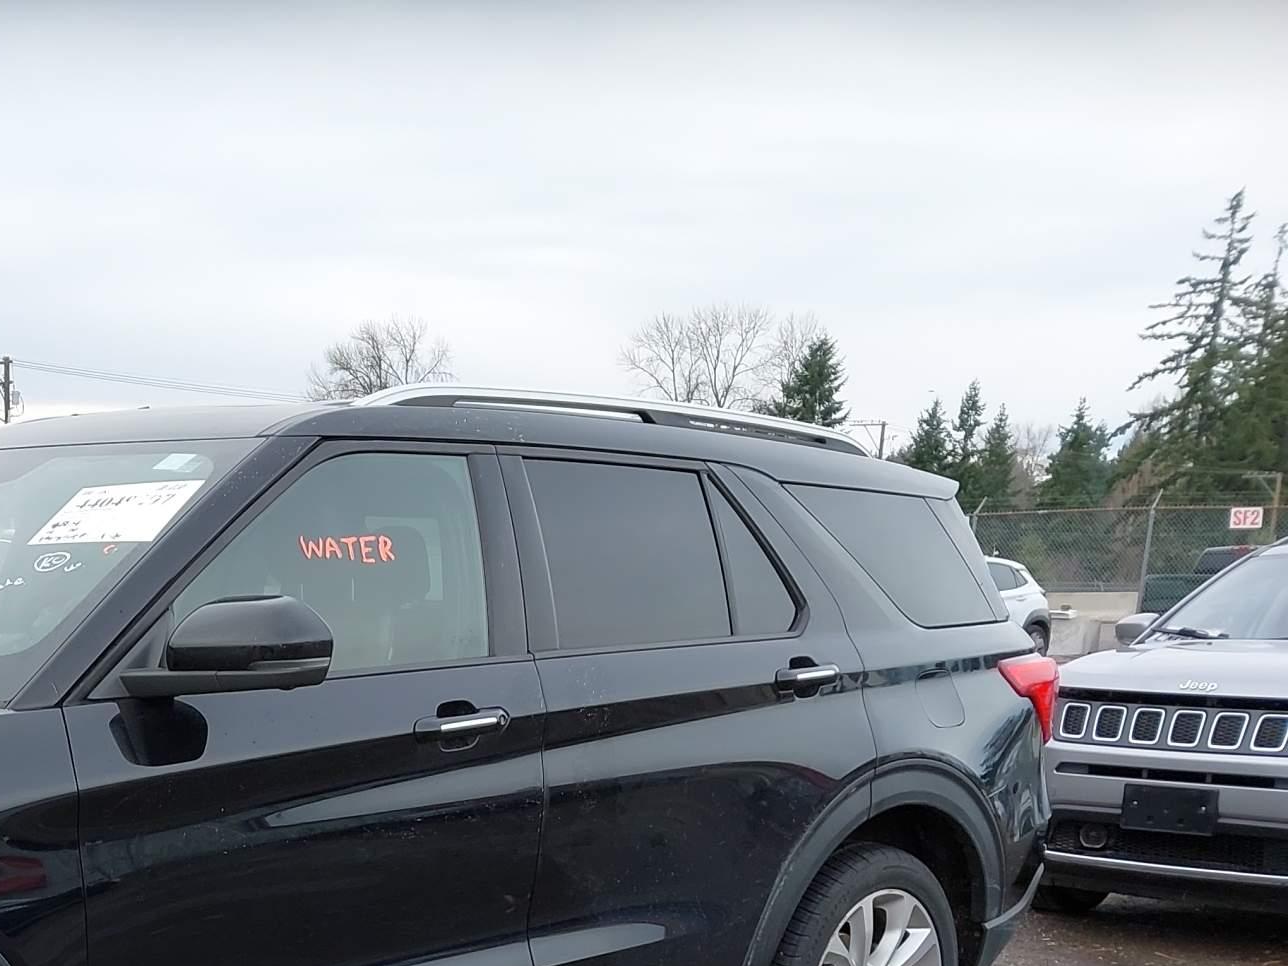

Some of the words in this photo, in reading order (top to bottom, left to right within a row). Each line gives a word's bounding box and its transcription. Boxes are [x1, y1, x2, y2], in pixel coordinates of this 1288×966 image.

[1232, 509, 1260, 526] SF2
[299, 535, 395, 563] WATER
[1179, 679, 1218, 692] Jeep
